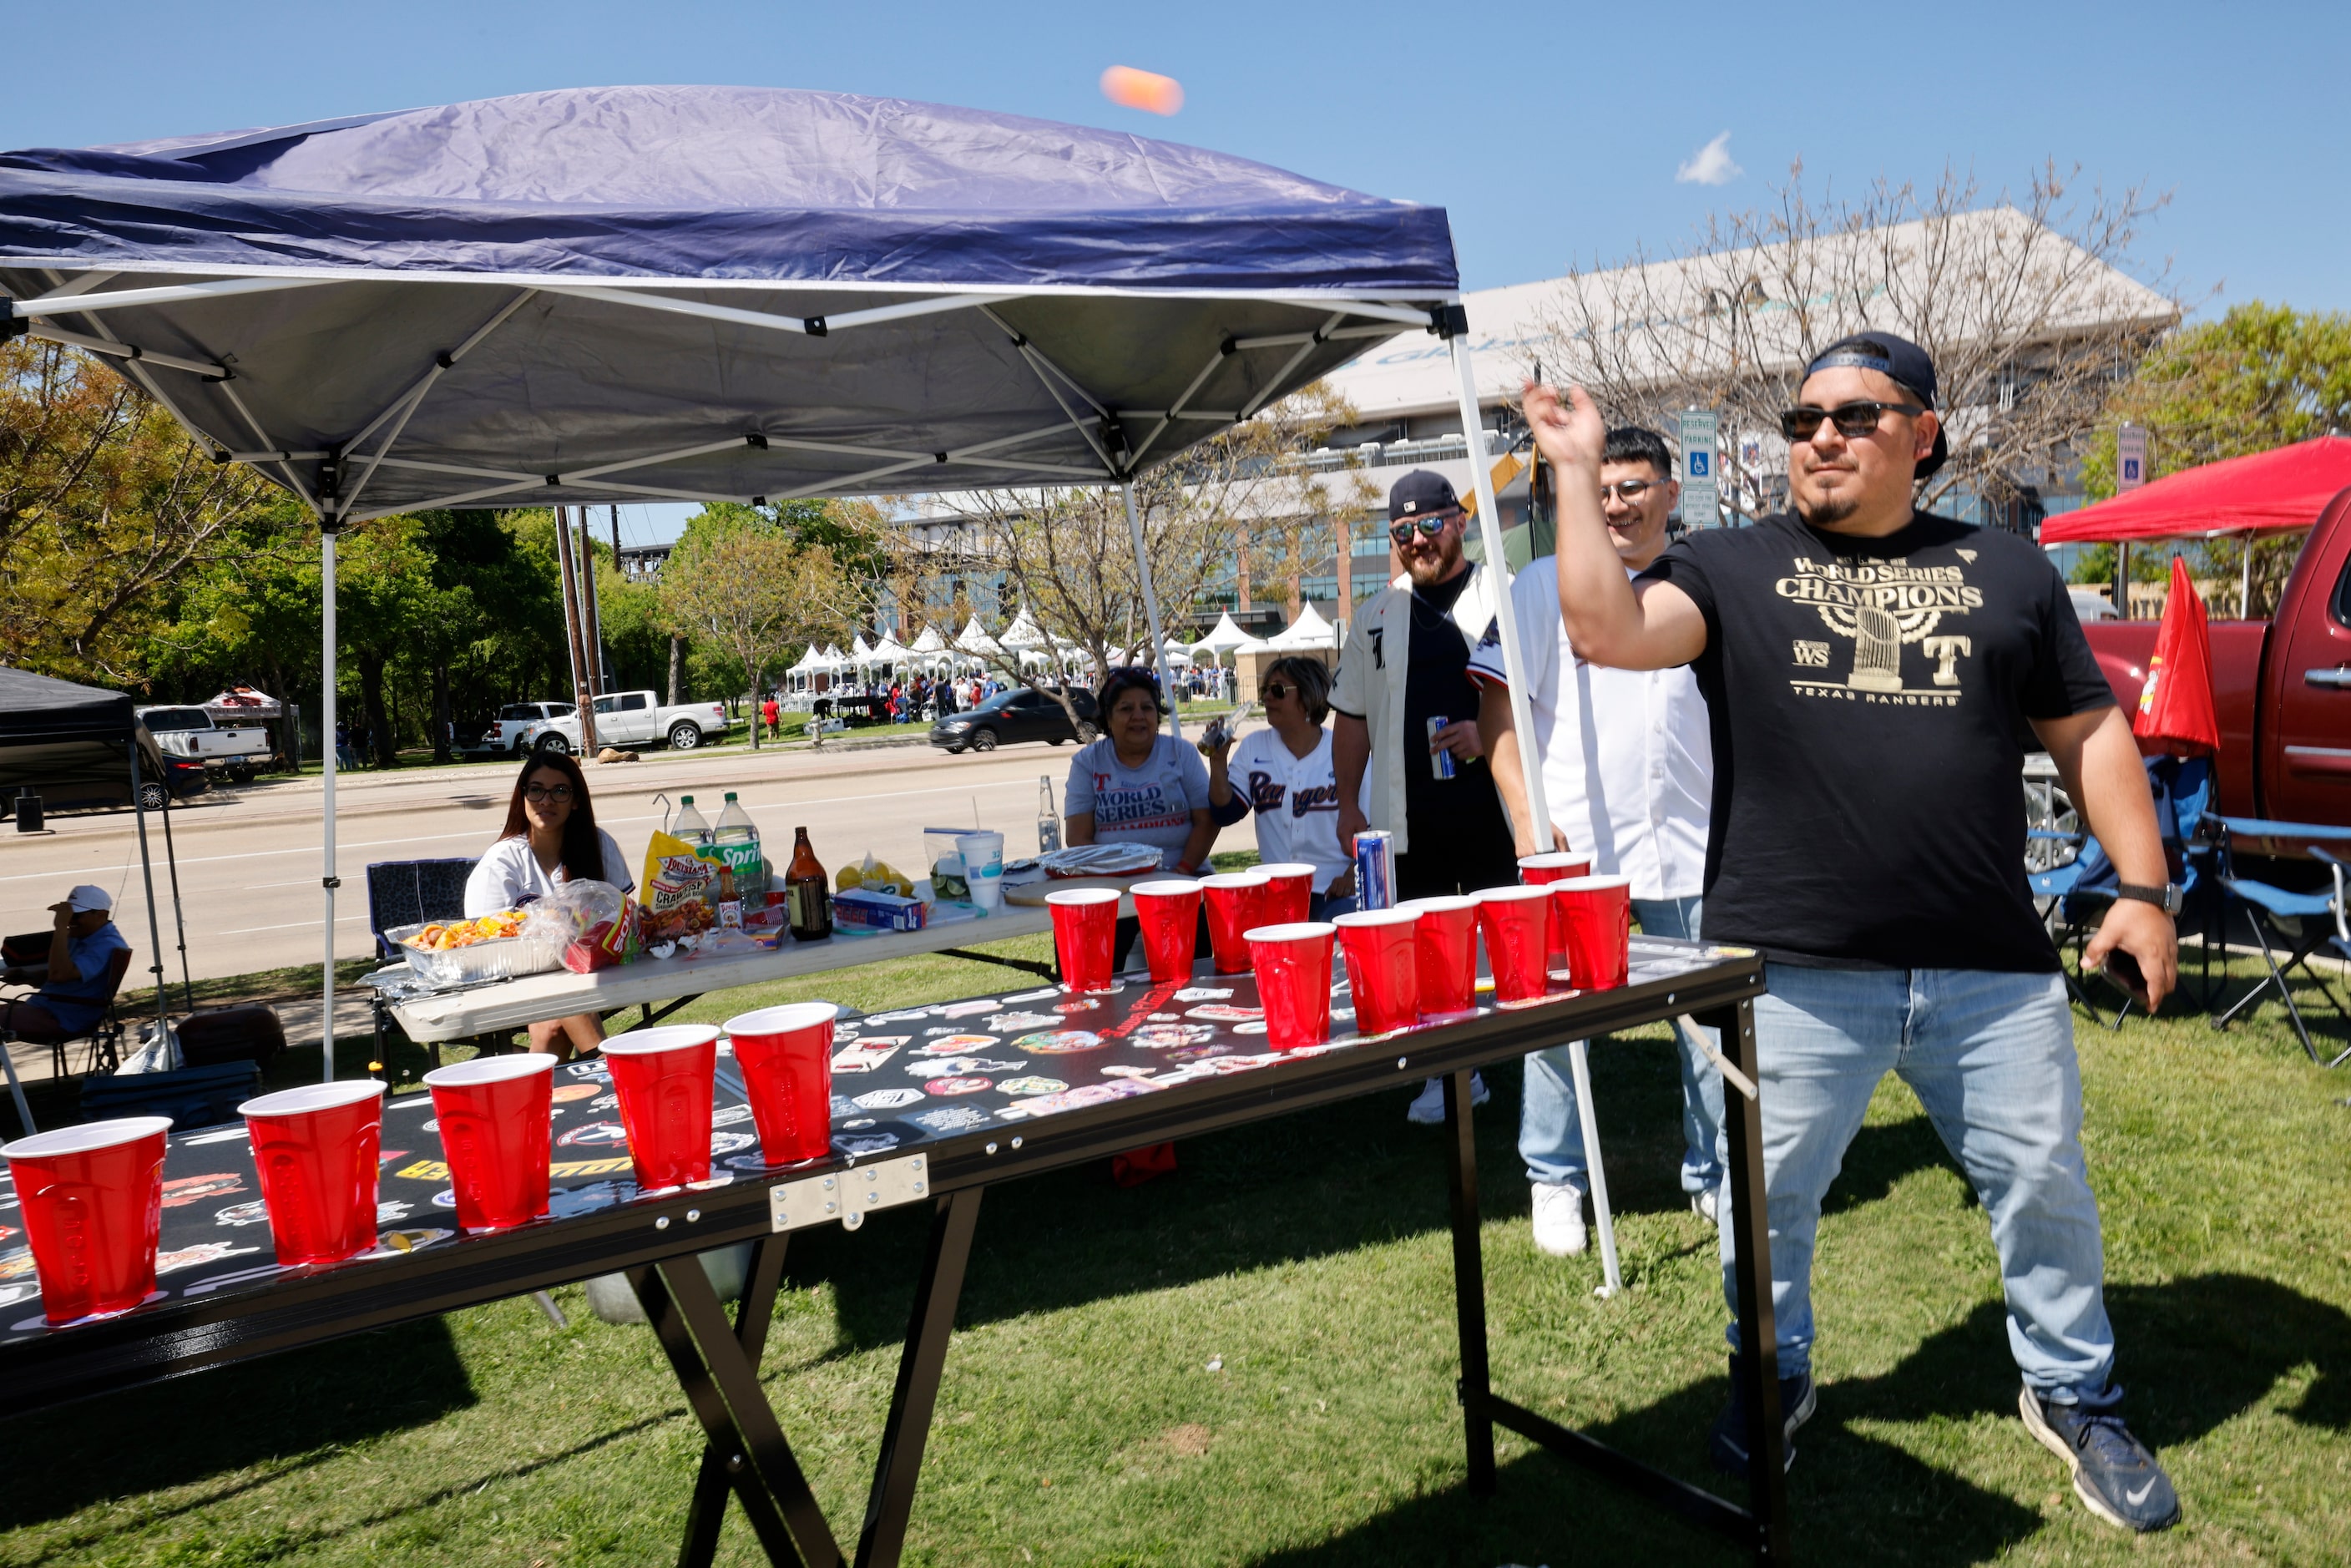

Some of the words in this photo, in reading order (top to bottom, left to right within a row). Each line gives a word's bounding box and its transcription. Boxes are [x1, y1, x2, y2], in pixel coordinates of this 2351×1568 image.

[1682, 420, 1714, 428] RESERVED
[1685, 435, 1713, 445] PARKING
[1794, 558, 1876, 584] WORLD
[1878, 566, 1964, 582] SERIES
[1776, 578, 1984, 610] CHAMPIONS
[1793, 648, 1830, 665] WS
[1923, 635, 1971, 686] T
[1793, 686, 1856, 701] TEXAS
[1865, 693, 1958, 707] RANGERS
[1093, 772, 1111, 792] T
[1096, 787, 1161, 807] WORLD
[1095, 799, 1165, 822] SERIES
[667, 857, 709, 874] LOUISIANA
